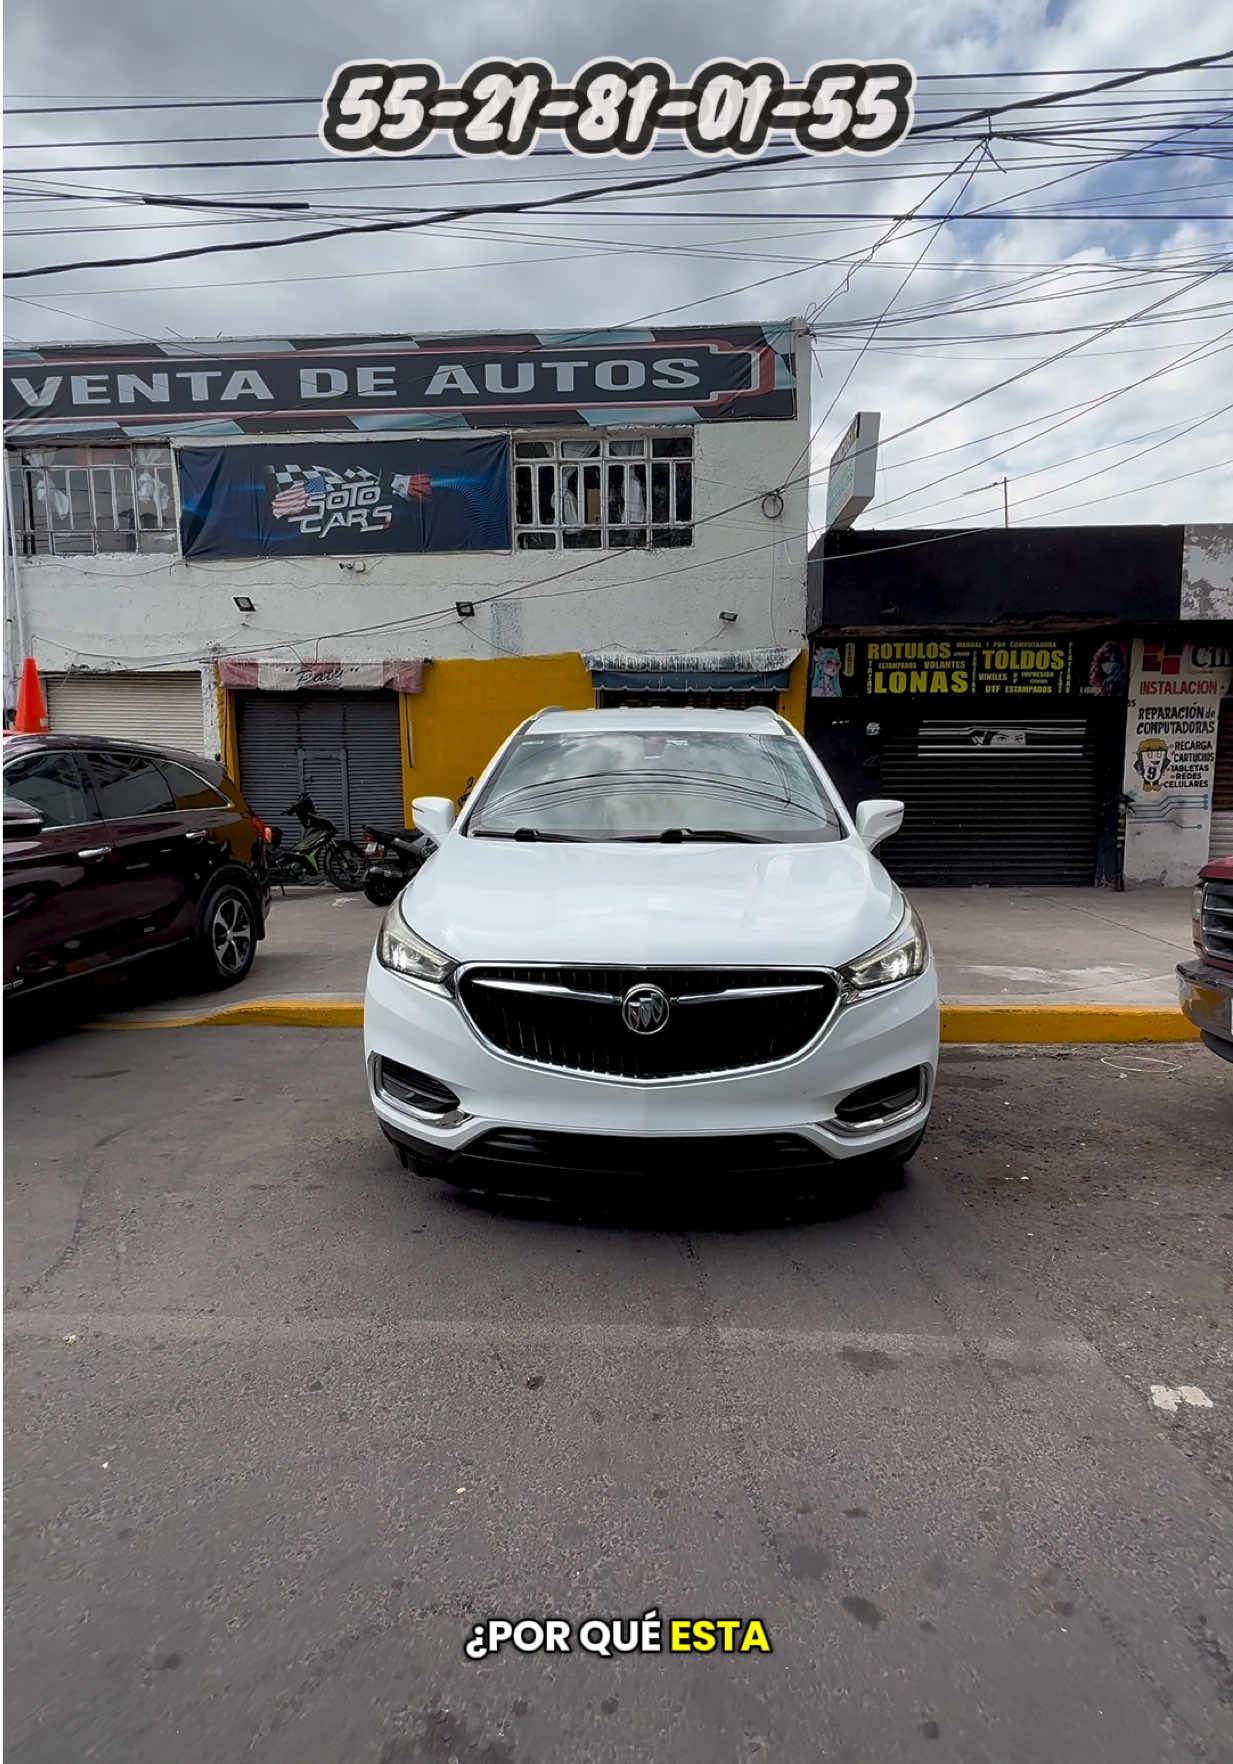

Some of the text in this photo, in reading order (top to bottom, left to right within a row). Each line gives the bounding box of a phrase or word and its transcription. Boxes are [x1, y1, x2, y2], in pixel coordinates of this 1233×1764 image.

[10, 358, 701, 407] VENTA DE AUTOS
[305, 480, 381, 519] SOTO
[288, 505, 393, 538] CARS
[866, 642, 951, 660] ROTULOS
[923, 661, 966, 670] VOLANTES
[982, 650, 1065, 671] TOLDOS
[873, 671, 969, 695] LONAS
[1004, 685, 1053, 694] ESTAMPADOS
[1139, 680, 1217, 695] INSTALACION
[1138, 702, 1216, 720] REPARACIÓN de
[1136, 721, 1215, 735] COMPUTADORAS
[1174, 740, 1213, 751] RECARGA
[1173, 752, 1215, 762] CARTUCHOS
[1169, 764, 1209, 772] TABLETAS
[1175, 772, 1202, 780] REDES
[1163, 780, 1209, 788] CELULARES
